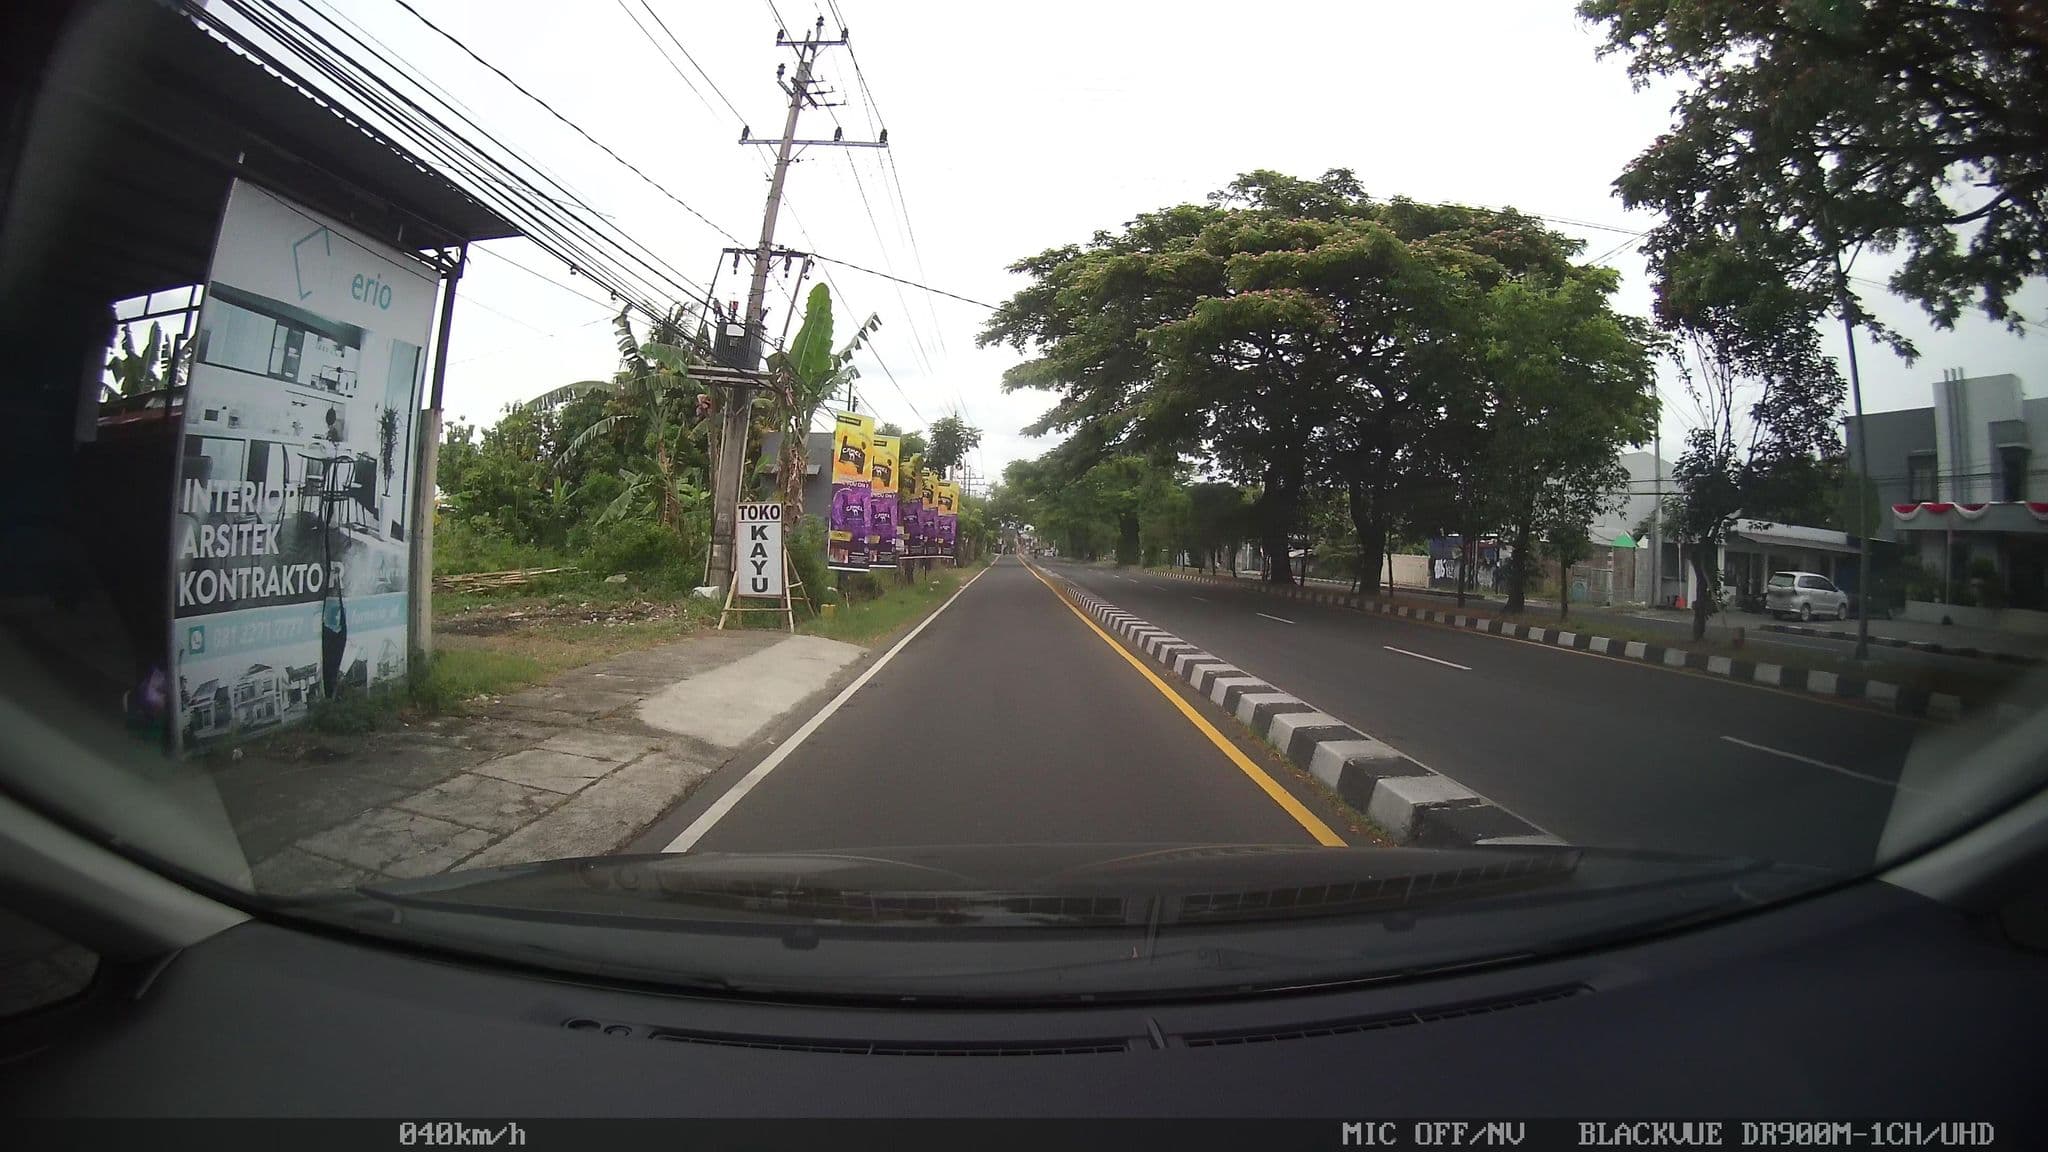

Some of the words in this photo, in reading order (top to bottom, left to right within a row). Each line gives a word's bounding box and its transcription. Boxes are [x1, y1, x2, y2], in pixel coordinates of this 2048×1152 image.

[352, 273, 392, 310] erio
[842, 447, 862, 458] CAMEL
[183, 478, 300, 514] INTERIOR
[738, 504, 781, 521] TOKO
[180, 523, 281, 560] ARSITEK
[750, 525, 769, 593] KAYU
